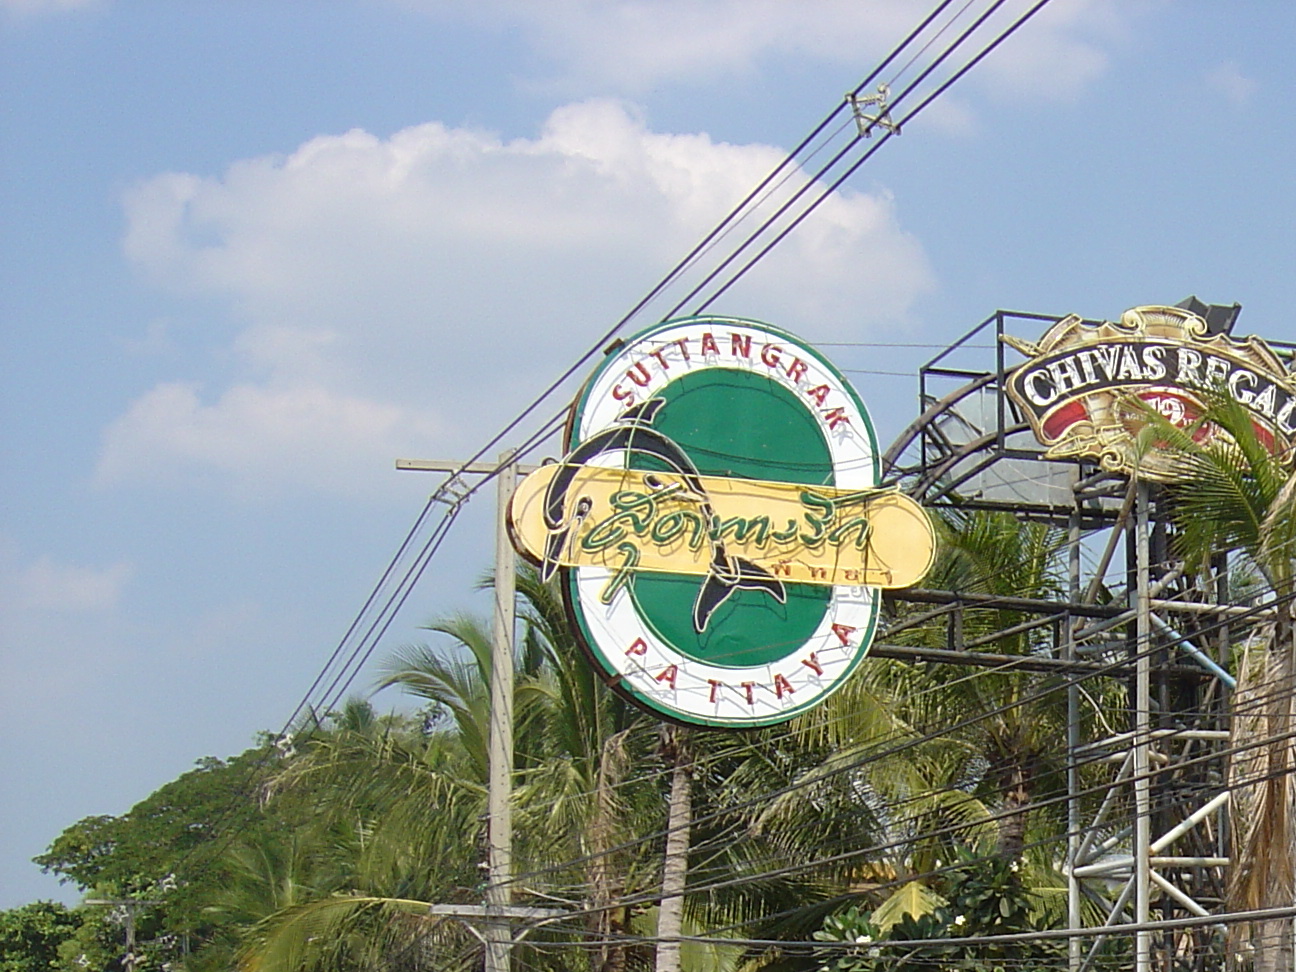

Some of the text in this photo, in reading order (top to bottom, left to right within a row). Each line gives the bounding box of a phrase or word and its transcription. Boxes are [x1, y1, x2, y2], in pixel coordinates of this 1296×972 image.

[613, 332, 851, 430] SUTTANGRAK
[1023, 343, 1166, 407] CHIVAS
[625, 622, 857, 704] PATTAYA
